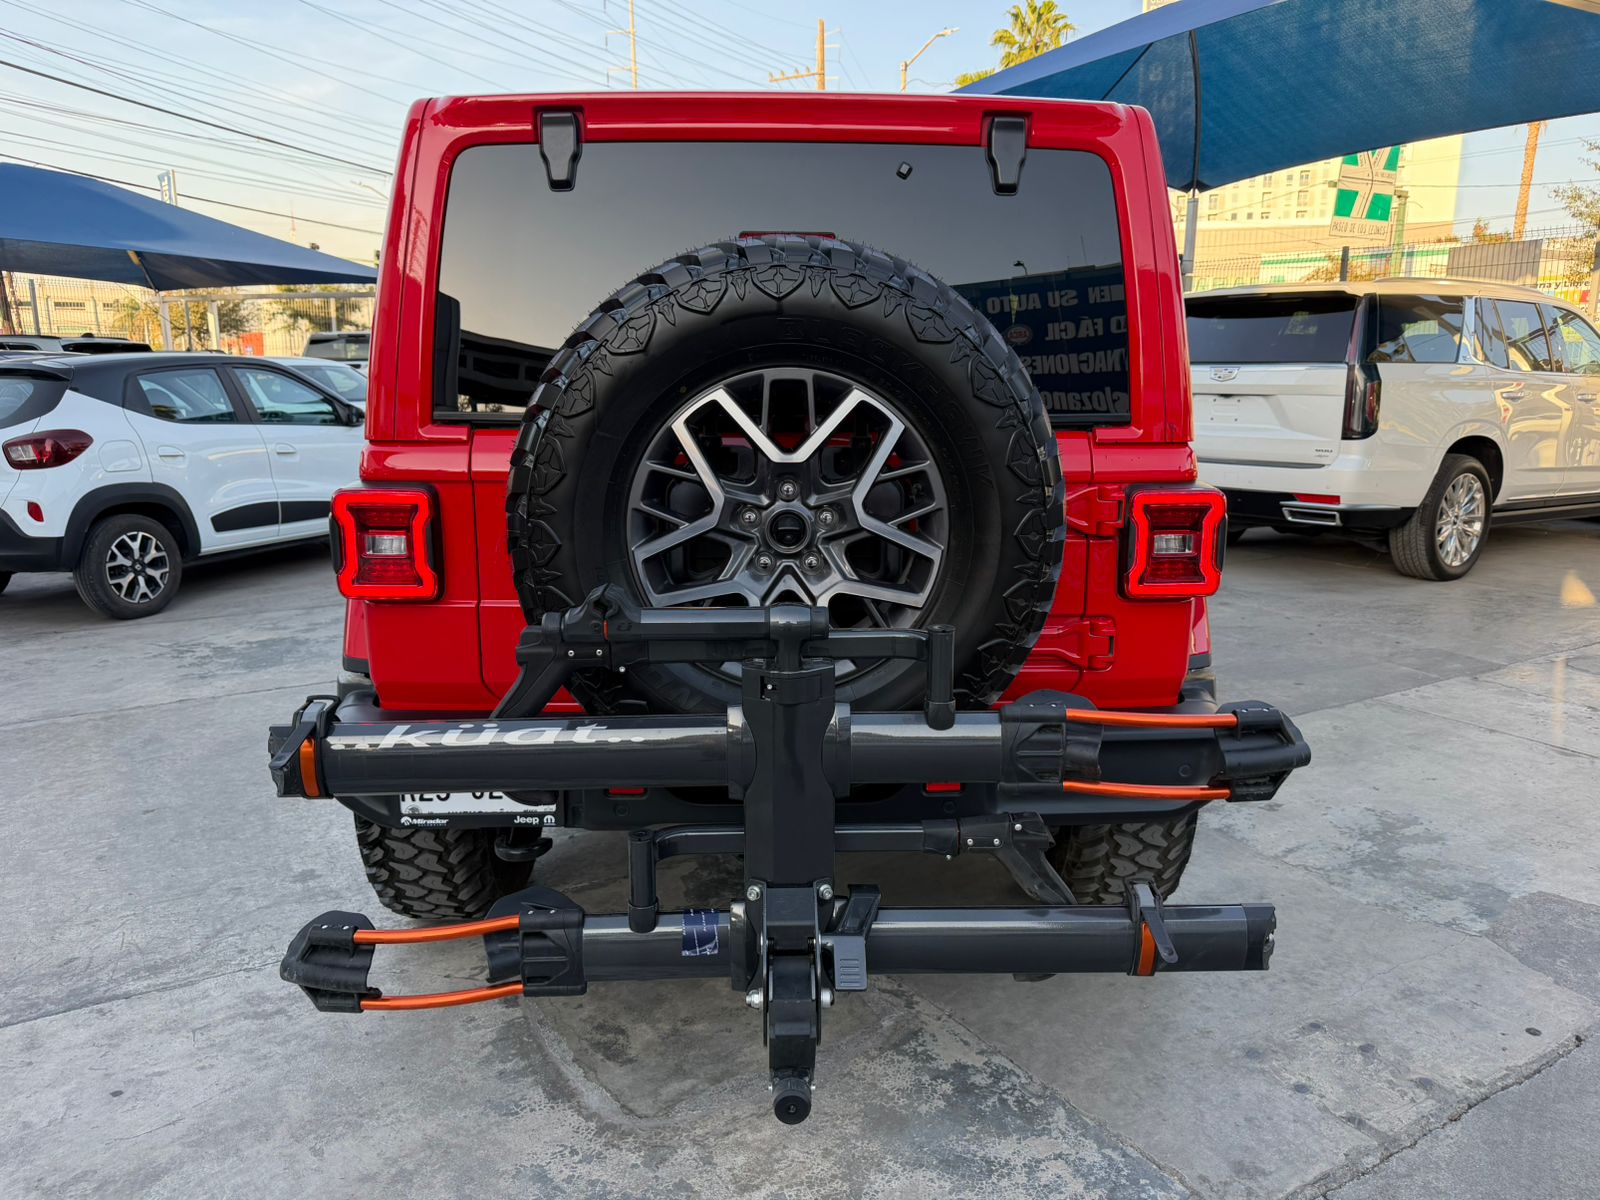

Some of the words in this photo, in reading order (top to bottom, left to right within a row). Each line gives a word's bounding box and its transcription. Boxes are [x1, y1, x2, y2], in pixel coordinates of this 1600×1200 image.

[1332, 221, 1349, 232] PASEO
[1349, 223, 1356, 233] DE
[1357, 223, 1367, 234] LOS
[513, 815, 540, 825] Jeep
